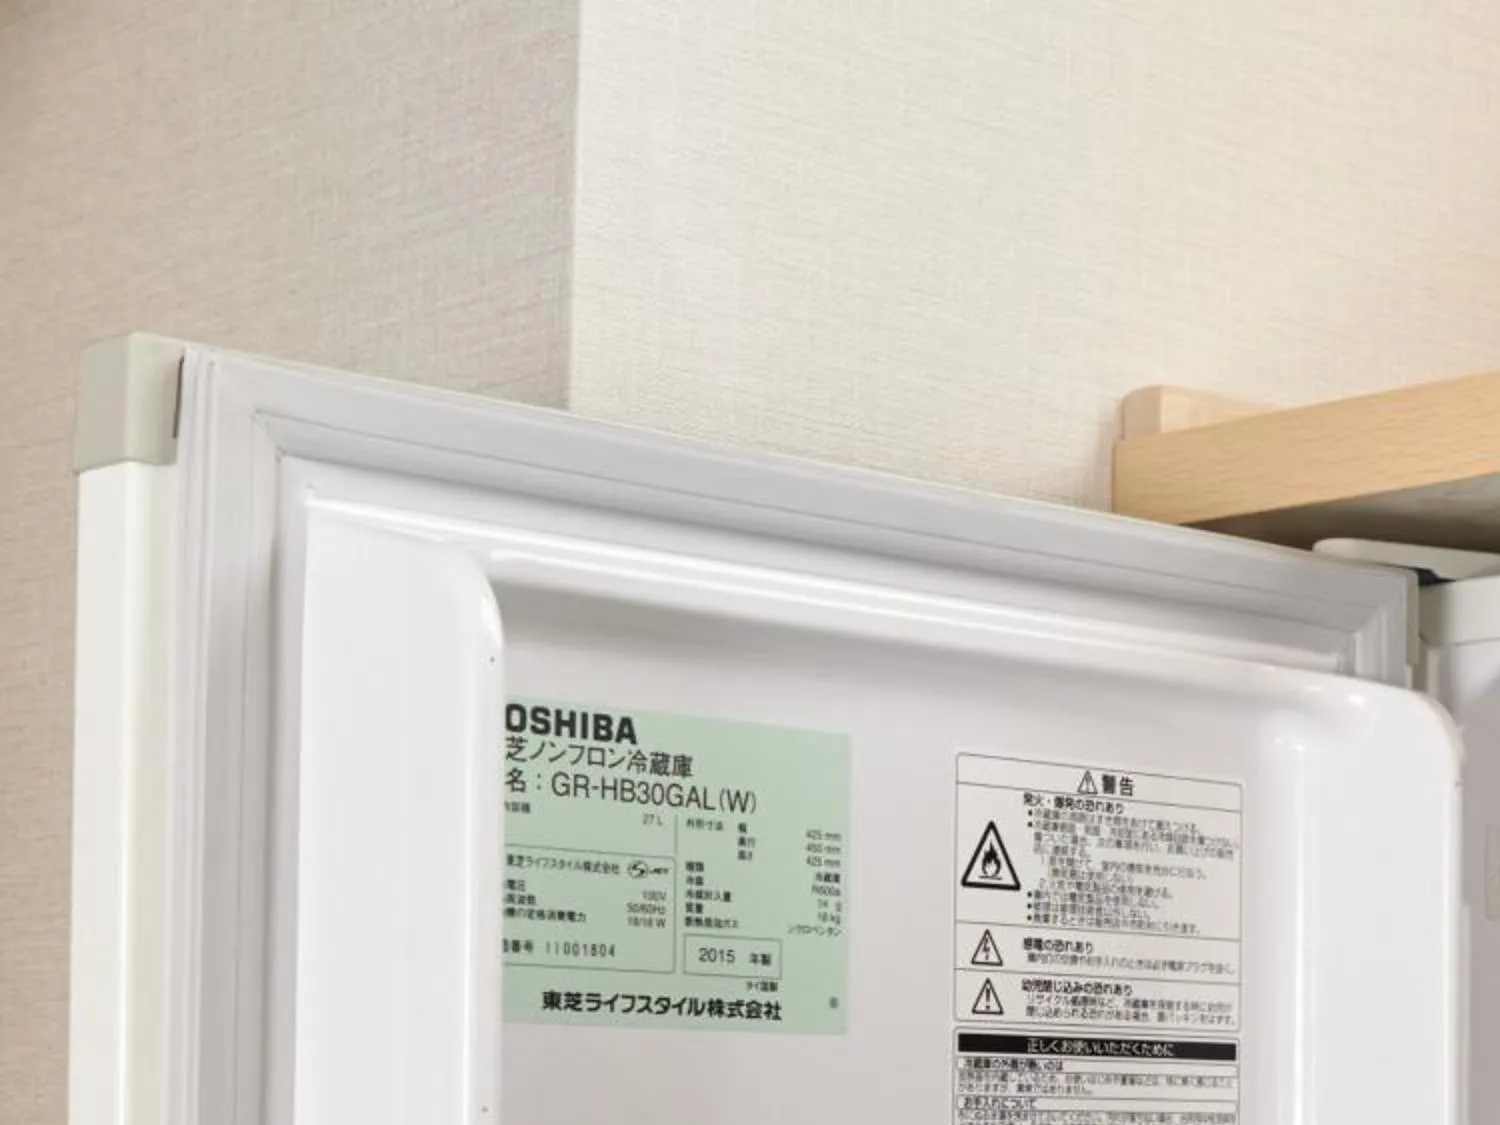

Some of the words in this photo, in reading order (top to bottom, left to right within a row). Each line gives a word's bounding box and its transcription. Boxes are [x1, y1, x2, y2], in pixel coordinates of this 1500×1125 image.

[504, 703, 638, 745] OSHIBA
[505, 736, 694, 778] 芝ノンフロン冷蔵庫
[551, 771, 757, 814] GR-HB30GAL(W)
[504, 879, 526, 892] 電圧
[504, 892, 537, 905] 周波数
[504, 906, 587, 923] 機の定格消費電力
[699, 947, 736, 964] 2015
[542, 990, 782, 1021] 東芝ライフスタイル株式会社
